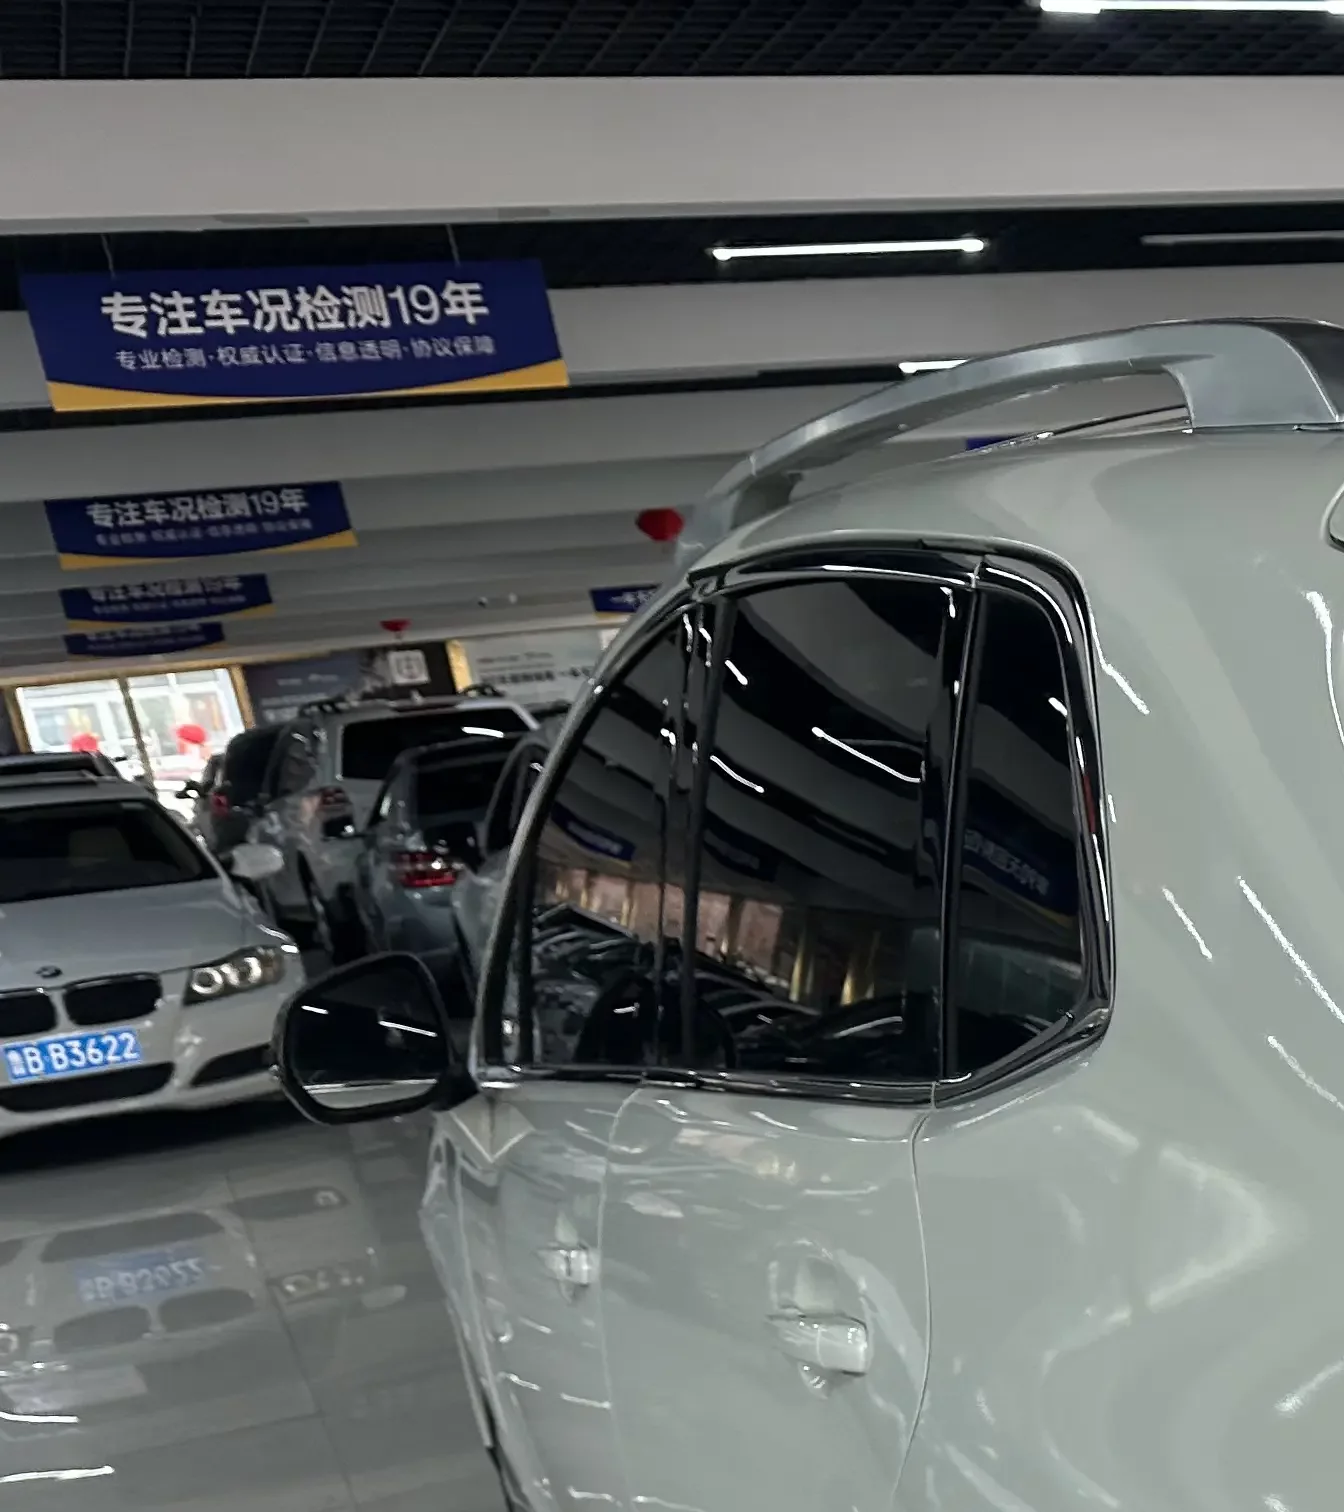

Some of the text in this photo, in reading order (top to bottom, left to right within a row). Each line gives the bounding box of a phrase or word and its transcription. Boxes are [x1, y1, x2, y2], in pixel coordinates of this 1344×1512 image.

[100, 279, 490, 339] 专注车况检测19年
[86, 488, 308, 528] 专注车况检测19年
